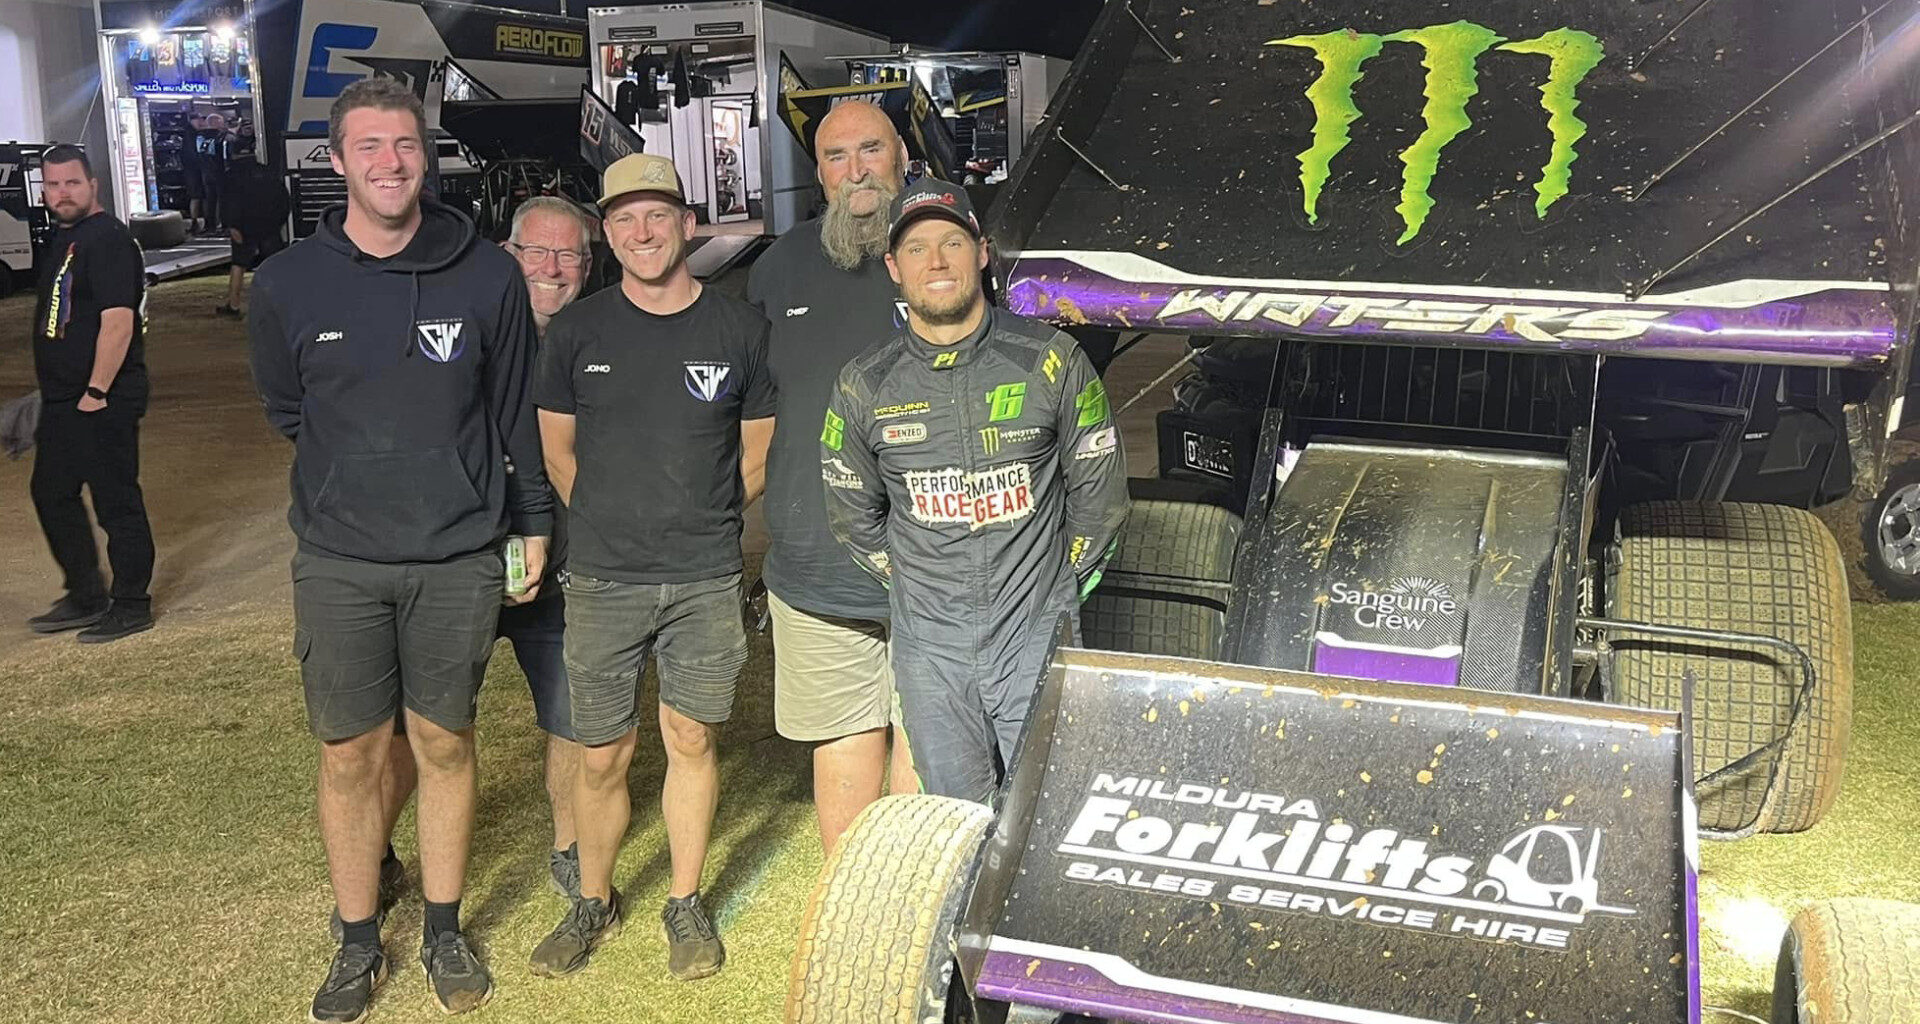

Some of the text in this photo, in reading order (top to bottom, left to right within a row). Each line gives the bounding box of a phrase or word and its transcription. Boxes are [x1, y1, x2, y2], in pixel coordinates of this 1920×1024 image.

[496, 25, 583, 58] AEROFLOW
[786, 307, 810, 317] CHIEF
[1157, 288, 1672, 343] WATERS
[316, 332, 343, 342] JOSH
[584, 364, 611, 374] JONO
[933, 352, 959, 368] P1
[1000, 427, 1041, 440] MONSTER
[911, 467, 1025, 499] PERFORMANCE
[1330, 582, 1456, 615] Sanguine
[1355, 605, 1427, 632] Crew
[1091, 773, 1320, 818] MILDURA
[1062, 797, 1475, 897] Forklifts
[1064, 861, 1571, 948] SALES SERVICE HIRE
